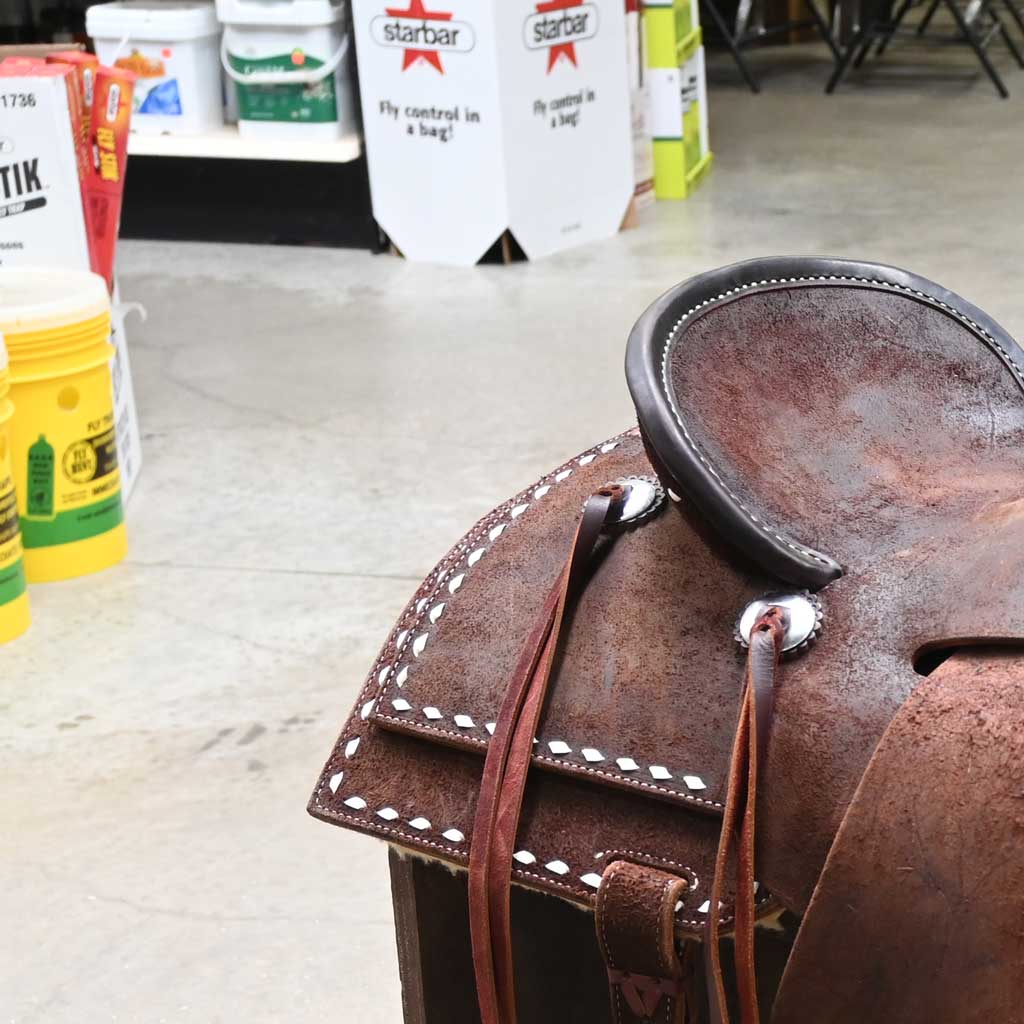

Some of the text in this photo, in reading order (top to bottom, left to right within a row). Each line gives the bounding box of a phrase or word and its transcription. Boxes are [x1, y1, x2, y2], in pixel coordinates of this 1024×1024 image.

[384, 19, 459, 45] starbar
[534, 9, 588, 42] starbar
[379, 99, 481, 122] Fly control in
[533, 87, 595, 117] Fly control in
[406, 123, 414, 135] a
